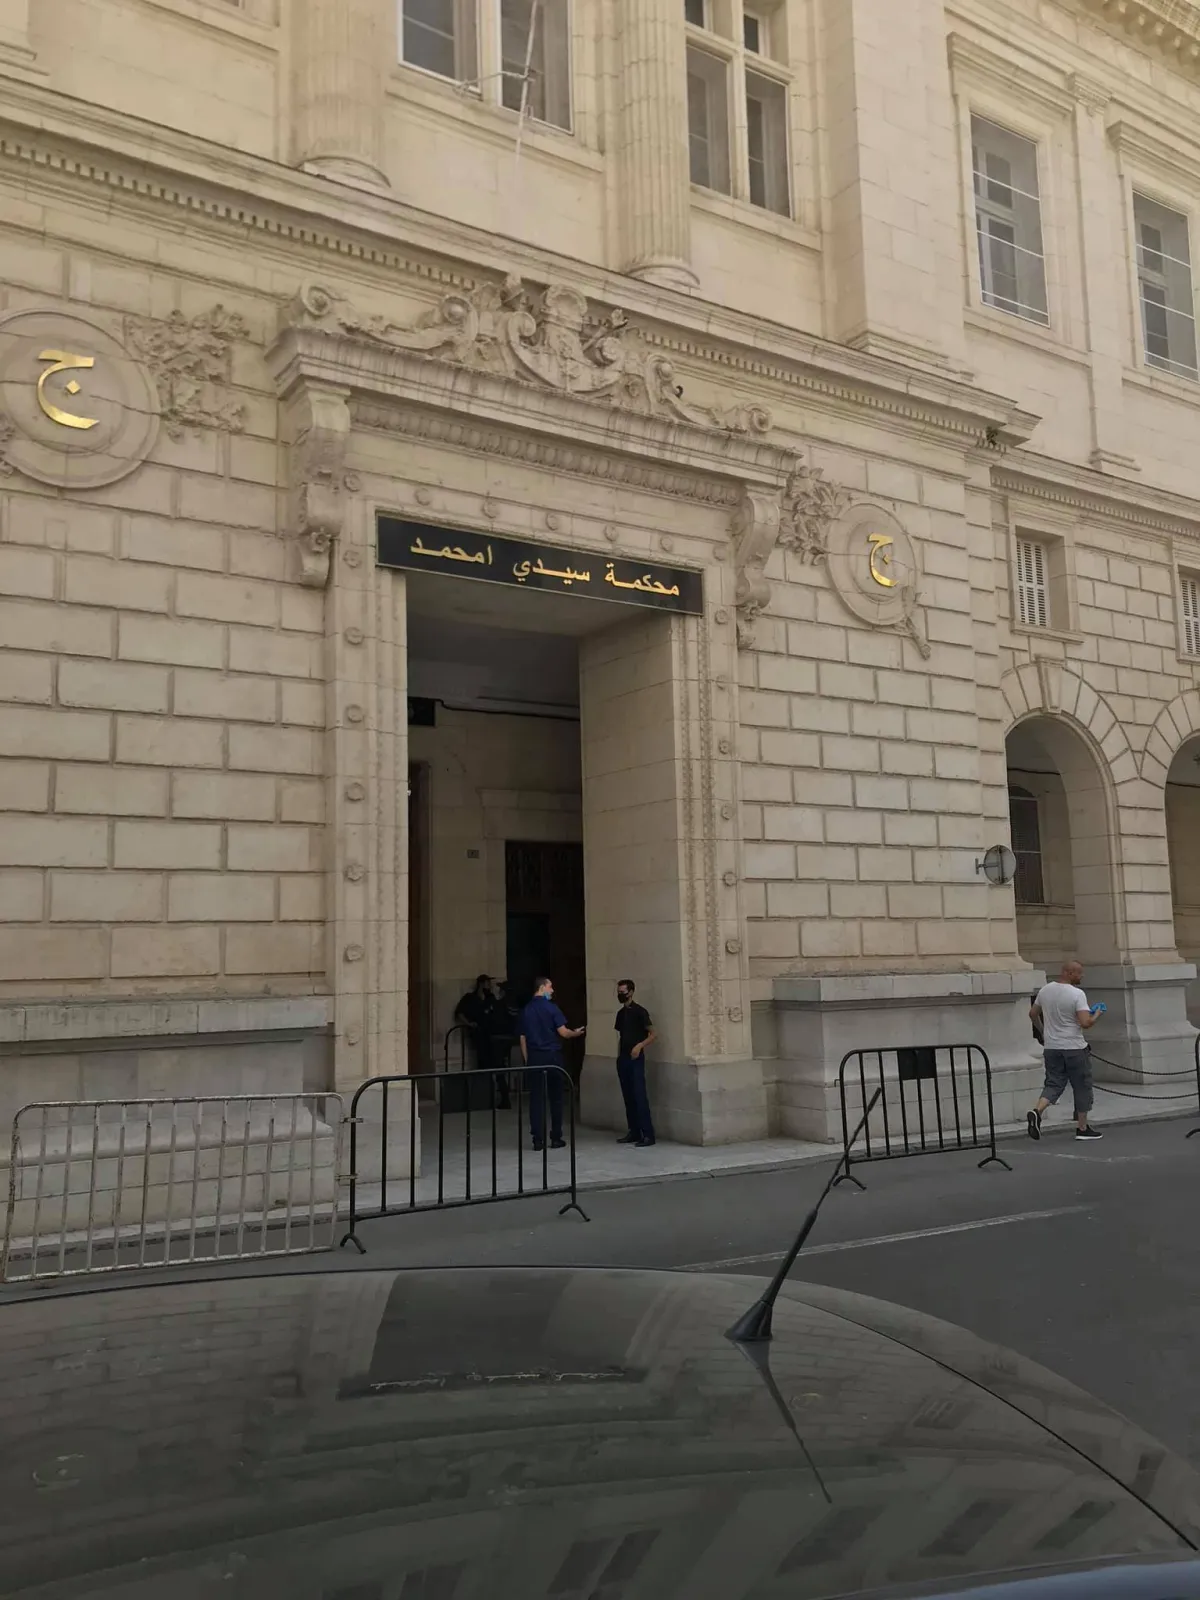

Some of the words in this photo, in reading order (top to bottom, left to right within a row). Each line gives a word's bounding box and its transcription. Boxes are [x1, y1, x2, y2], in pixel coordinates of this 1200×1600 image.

[37, 349, 100, 430] ج
[410, 537, 493, 565] امحمد
[868, 532, 900, 587] ج
[512, 558, 590, 585] سيدي
[604, 562, 680, 596] محكمة
